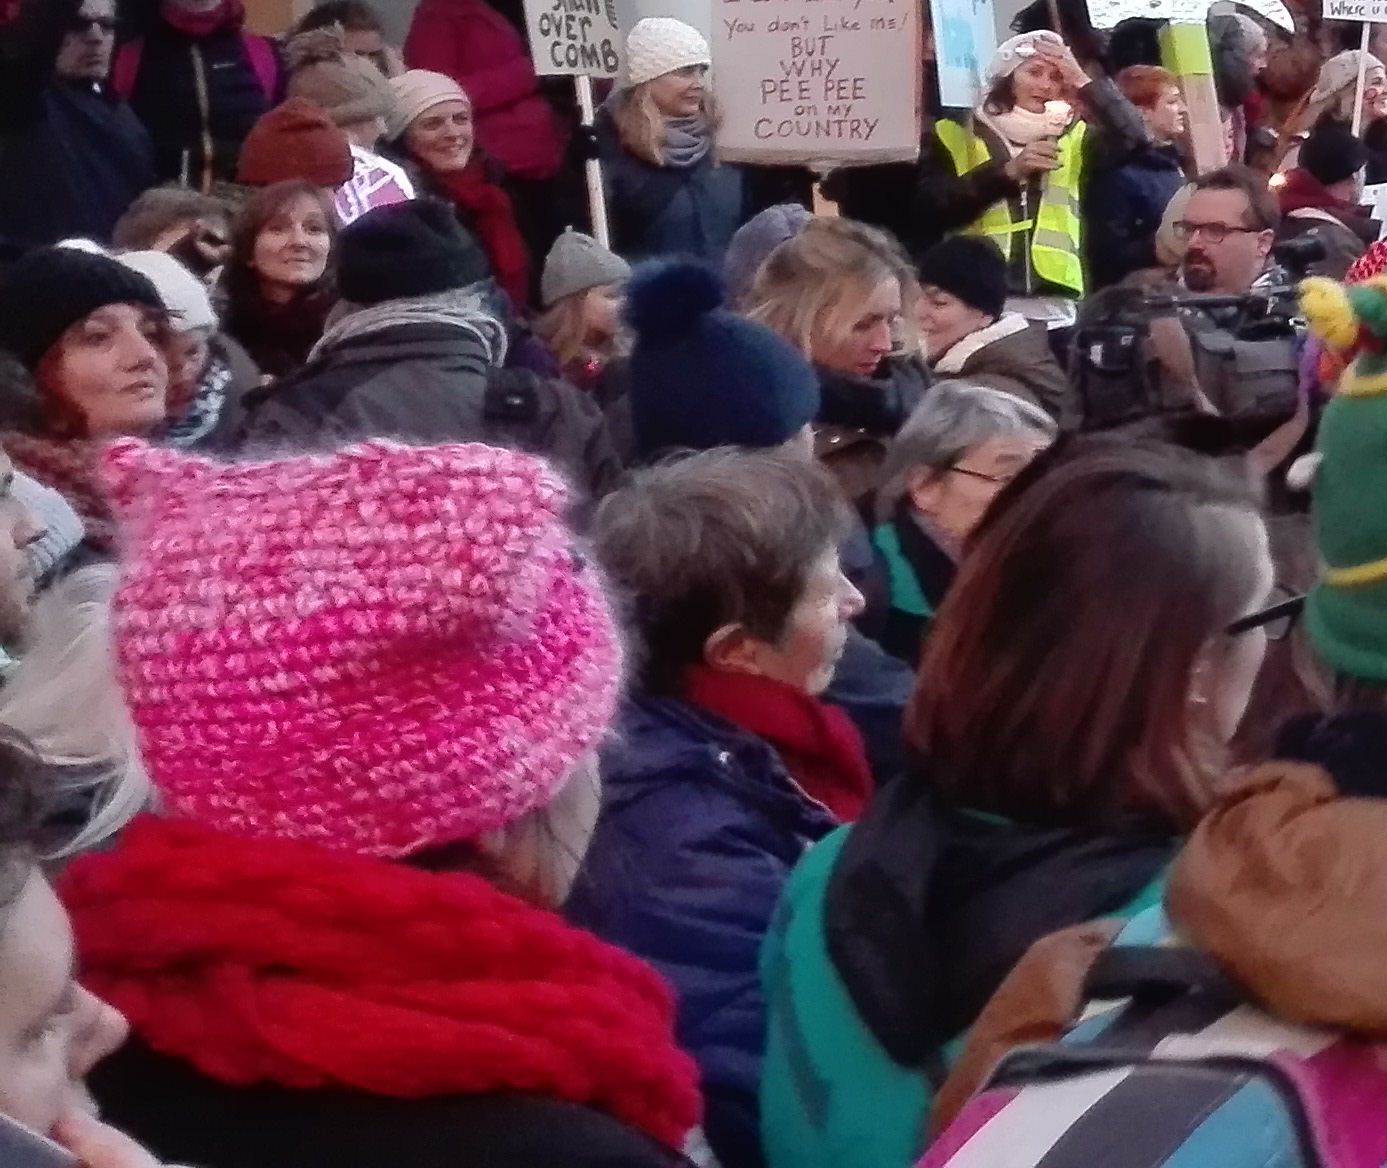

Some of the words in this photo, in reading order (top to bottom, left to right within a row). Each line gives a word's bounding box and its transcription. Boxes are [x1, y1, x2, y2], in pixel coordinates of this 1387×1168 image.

[550, 38, 619, 73] COMB
[791, 35, 834, 58] BUT
[779, 58, 840, 78] WHY
[761, 79, 811, 104] PEE
[824, 78, 867, 102] PEE
[753, 117, 880, 141] COUNTRY
